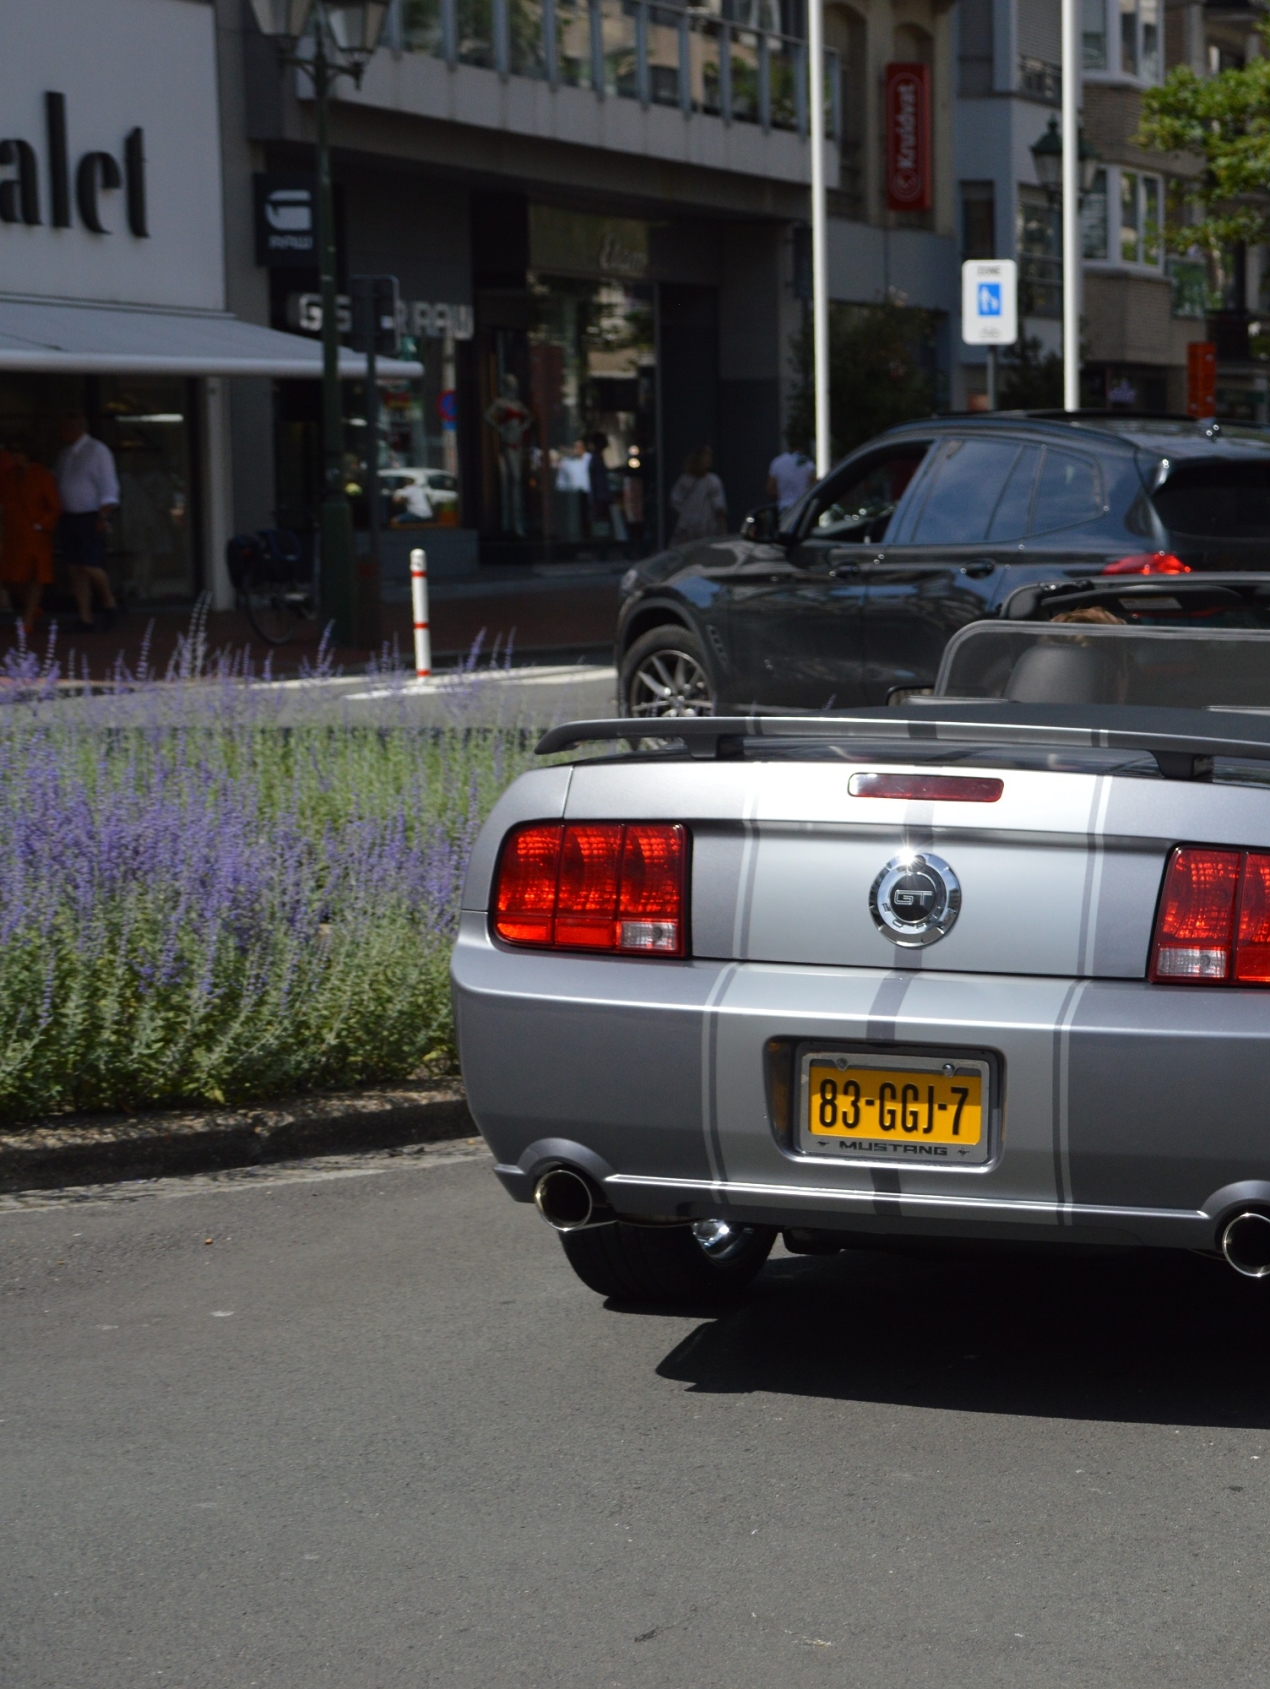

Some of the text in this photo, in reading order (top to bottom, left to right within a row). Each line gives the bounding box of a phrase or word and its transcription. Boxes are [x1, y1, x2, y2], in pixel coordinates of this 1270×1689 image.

[896, 84, 917, 170] Kruidvat
[894, 889, 933, 906] GT
[819, 1078, 969, 1136] 83-GGJ-7
[839, 1140, 948, 1156] MUSTANG
